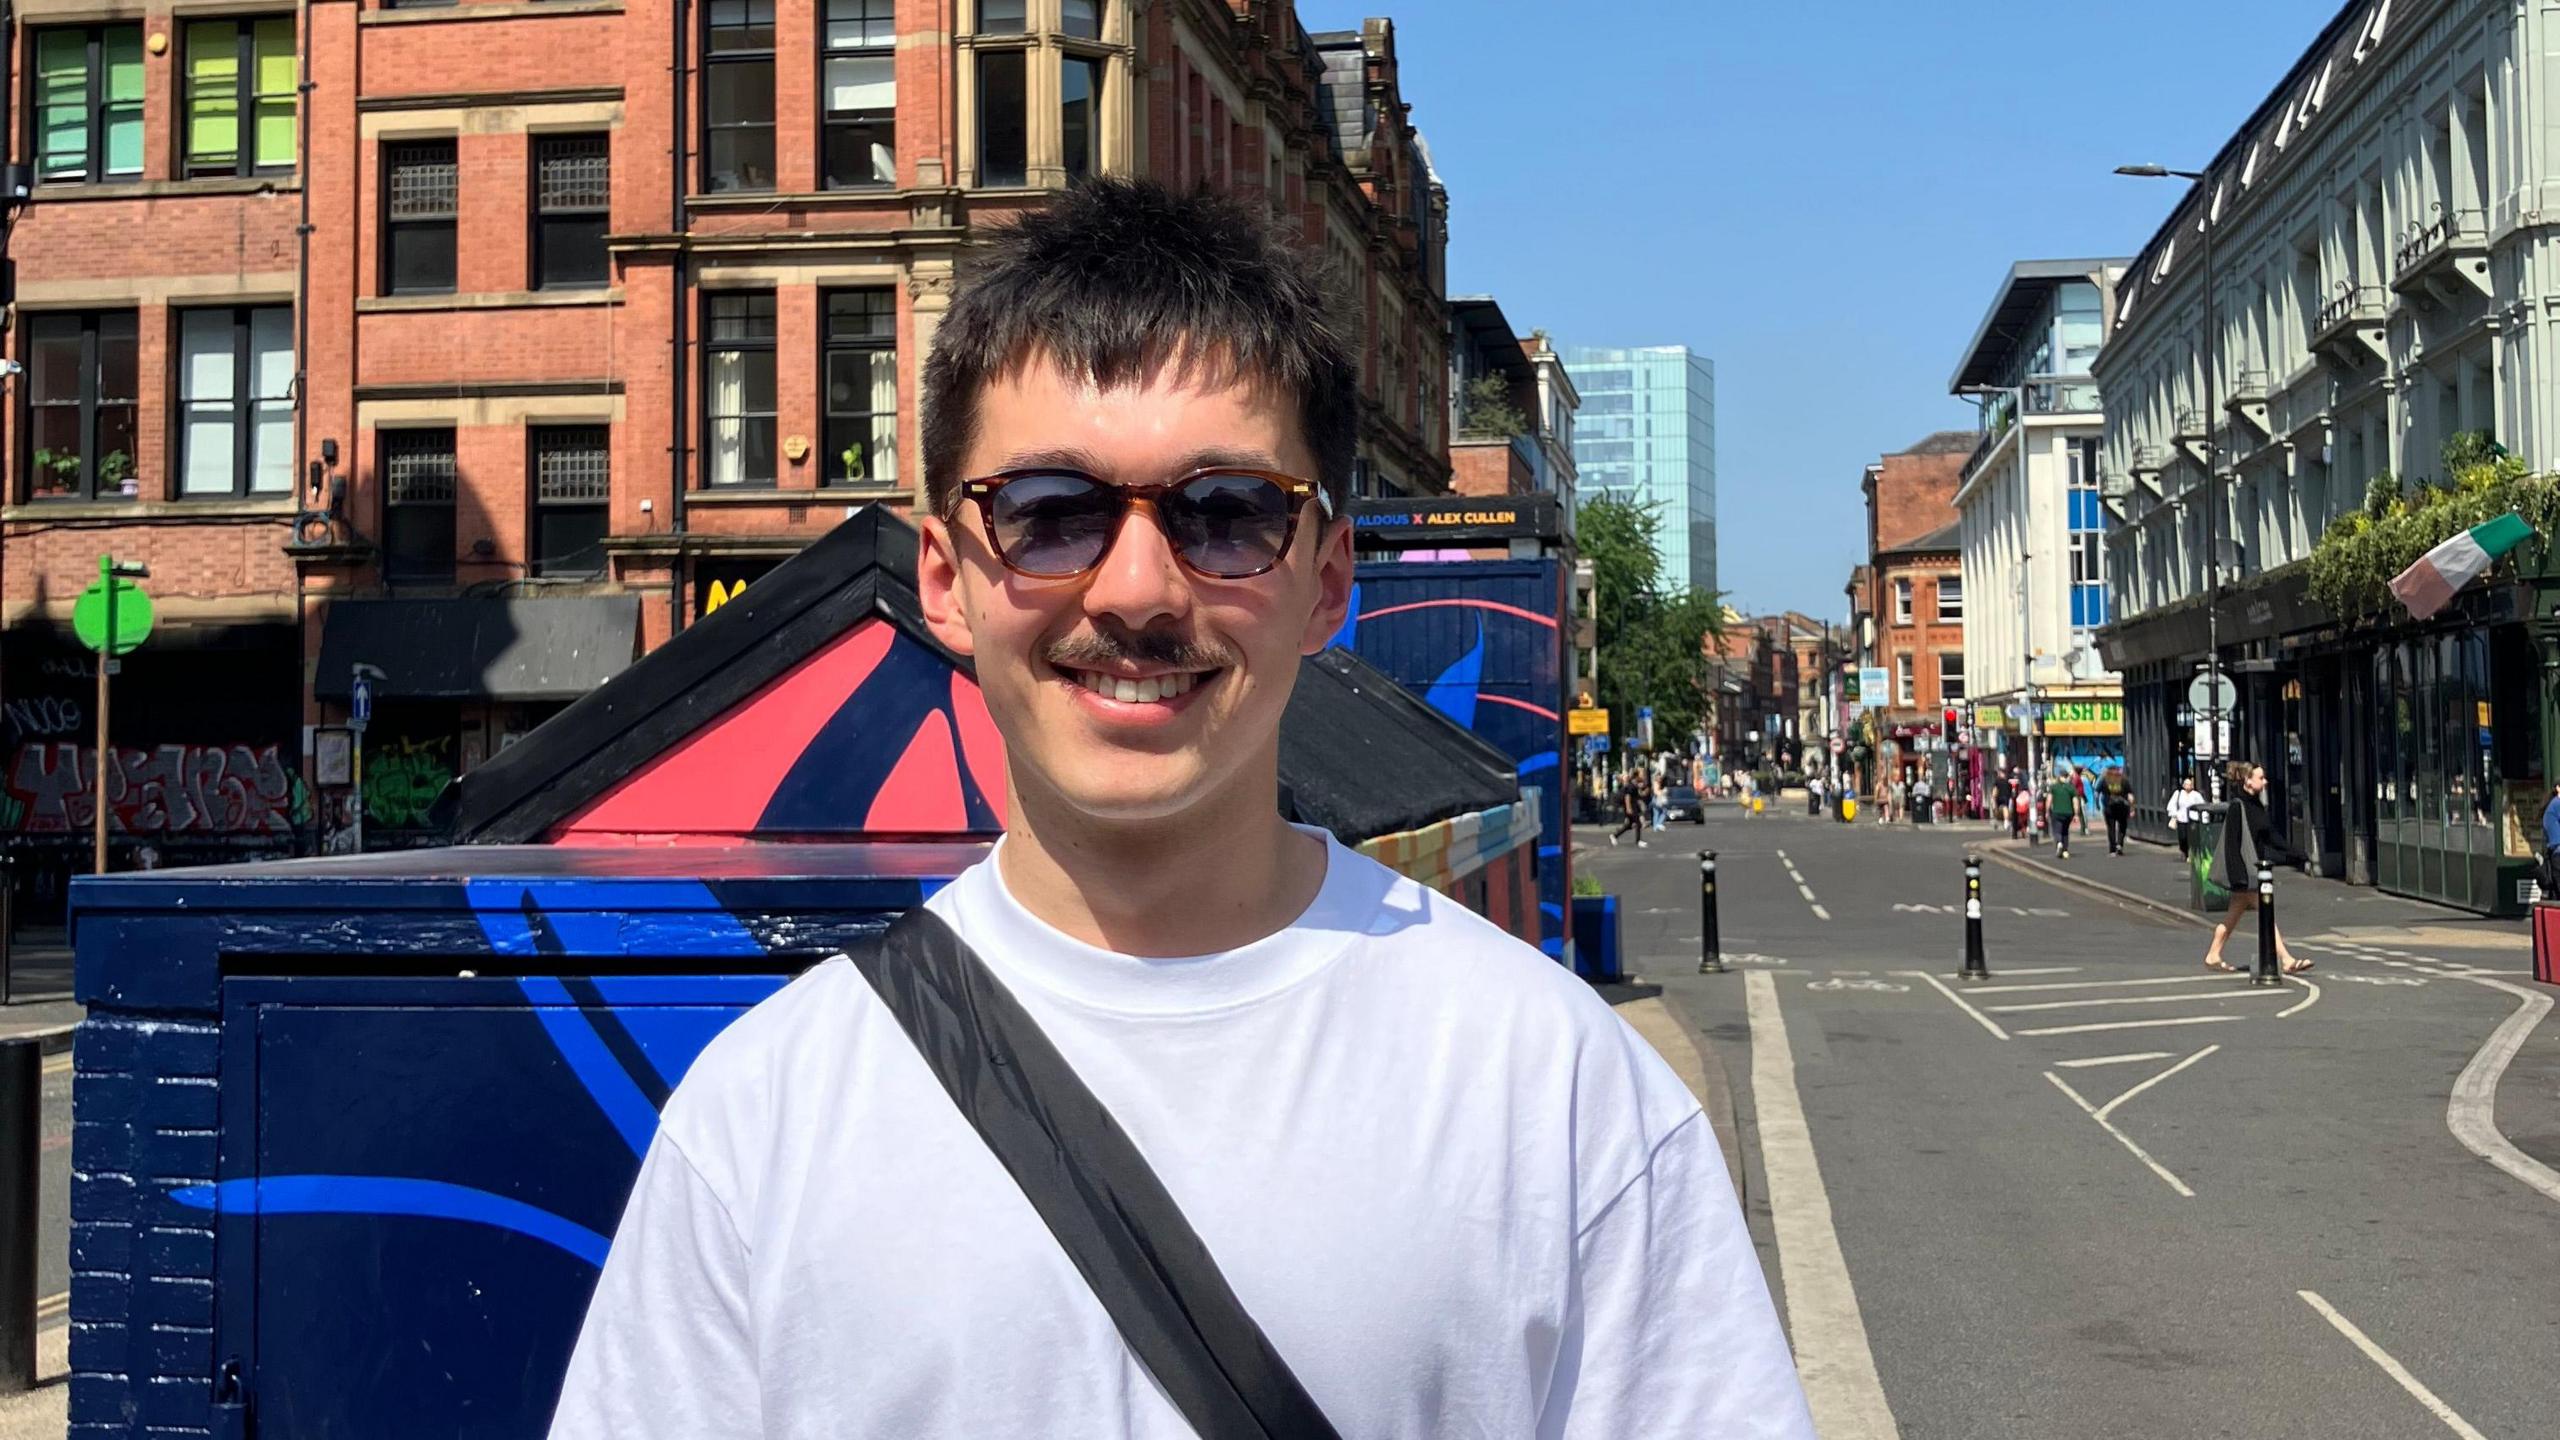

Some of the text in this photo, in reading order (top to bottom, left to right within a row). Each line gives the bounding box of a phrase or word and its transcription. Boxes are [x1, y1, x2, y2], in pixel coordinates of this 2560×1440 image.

[1356, 511, 1516, 527] ALDOUS X ALEX CULLEN
[2043, 702, 2095, 721] RESH
[2101, 702, 2123, 721] BI
